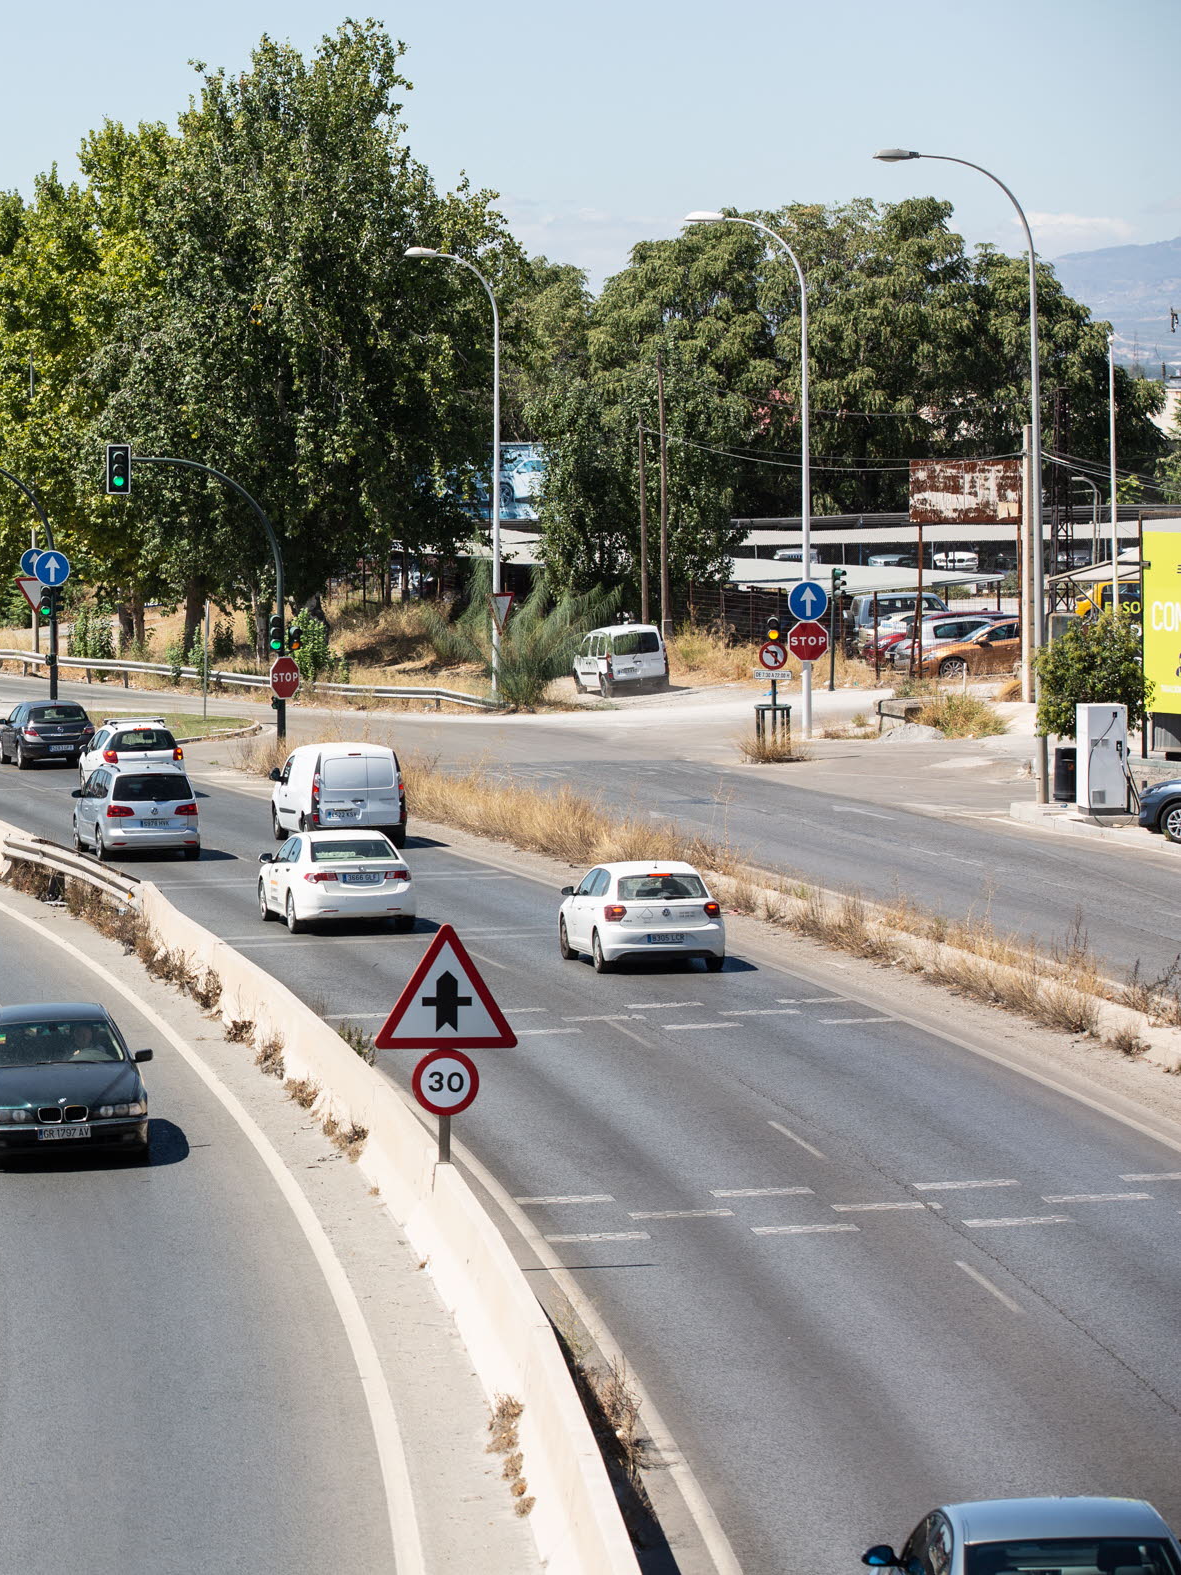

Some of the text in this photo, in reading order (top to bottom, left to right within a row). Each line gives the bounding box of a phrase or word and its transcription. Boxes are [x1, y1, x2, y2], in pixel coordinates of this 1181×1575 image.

[791, 636, 826, 646] STOP
[272, 672, 299, 683] STOP
[428, 1071, 464, 1093] 30
[43, 1128, 89, 1139] GR 1797 AV
